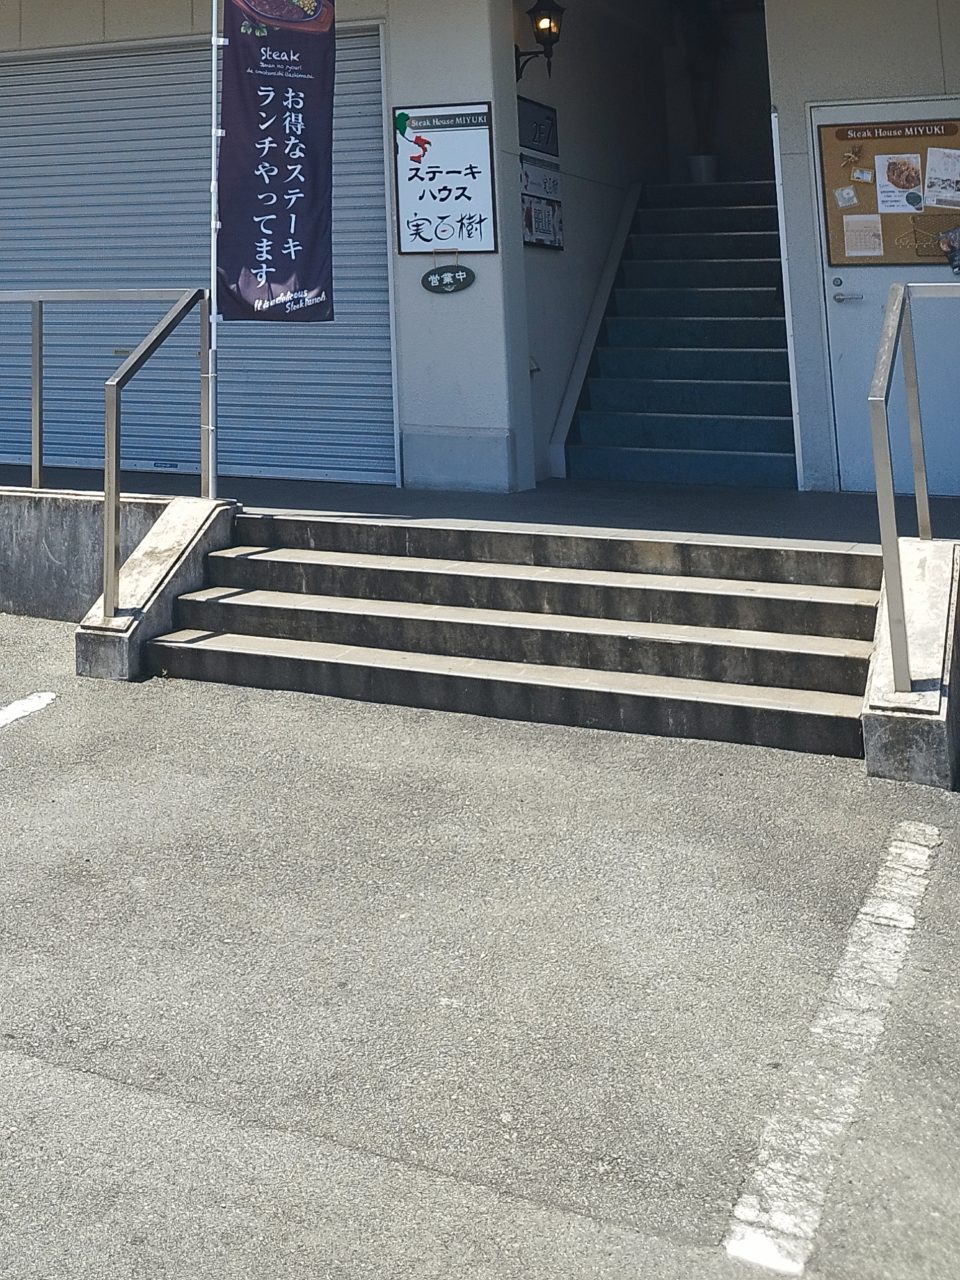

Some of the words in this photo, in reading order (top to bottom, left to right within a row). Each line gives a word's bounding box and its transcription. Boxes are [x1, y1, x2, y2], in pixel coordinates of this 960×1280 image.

[260, 46, 300, 62] Steak
[411, 118, 431, 127] Steak
[432, 117, 454, 126] House
[455, 115, 488, 124] MIYUKI
[847, 129, 872, 138] Steak
[874, 128, 902, 137] House
[904, 125, 945, 136] MIYUKI
[282, 87, 306, 261] お得なステーキ
[407, 163, 482, 182] ステーキ
[250, 85, 279, 289] ランチやってます
[418, 186, 472, 202] ハウス
[427, 270, 467, 287] 営業中
